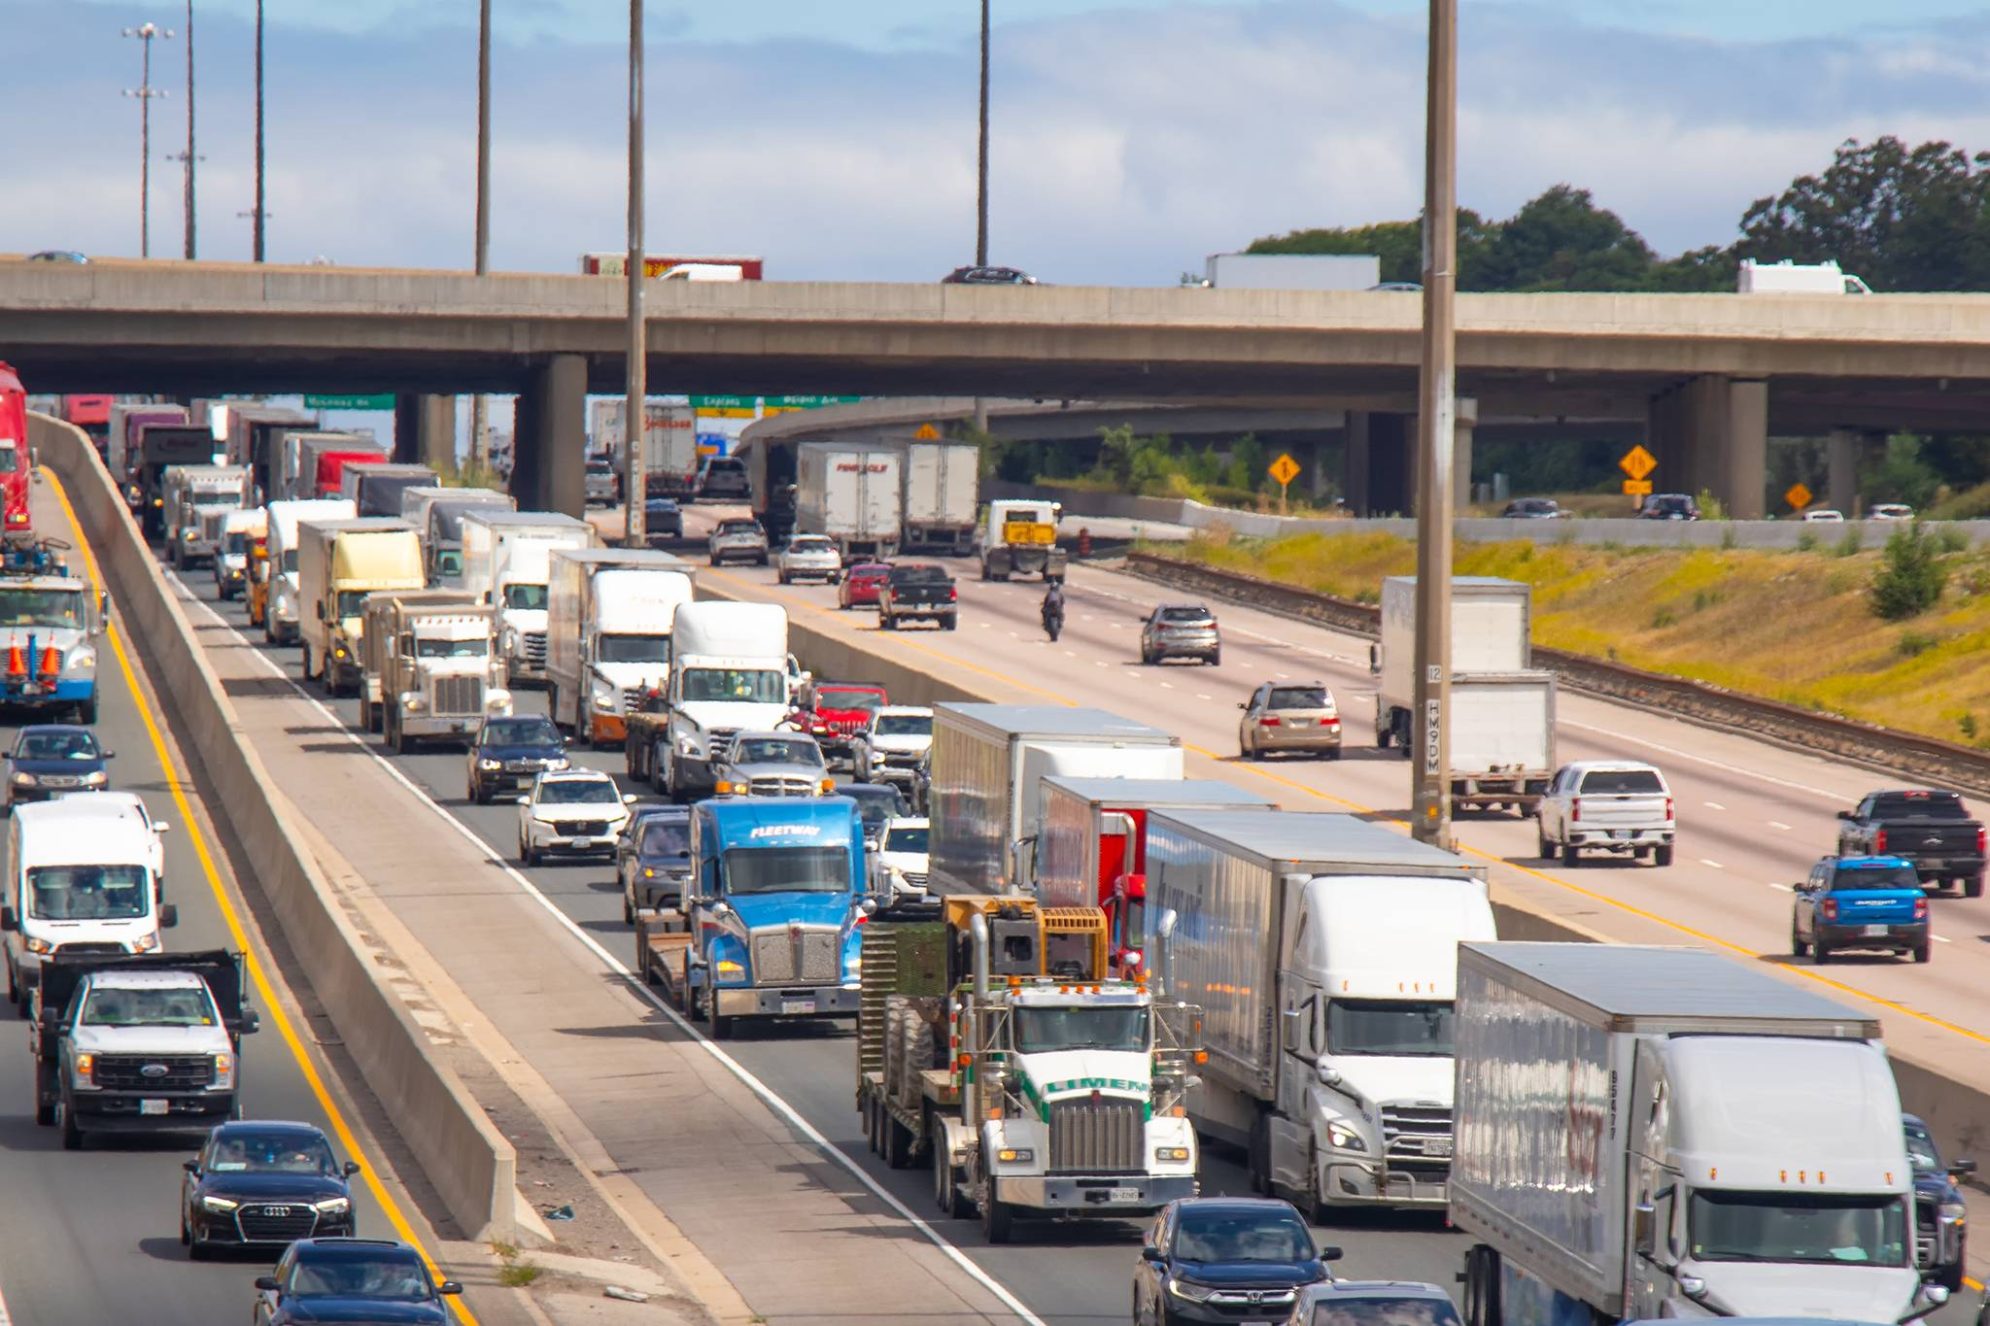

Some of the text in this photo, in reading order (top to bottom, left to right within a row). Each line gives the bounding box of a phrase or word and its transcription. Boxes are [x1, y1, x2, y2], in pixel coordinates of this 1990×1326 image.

[1428, 668, 1440, 680] 12
[750, 824, 821, 839] FLEETWAY
[1046, 1077, 1149, 1093] LIMEN
